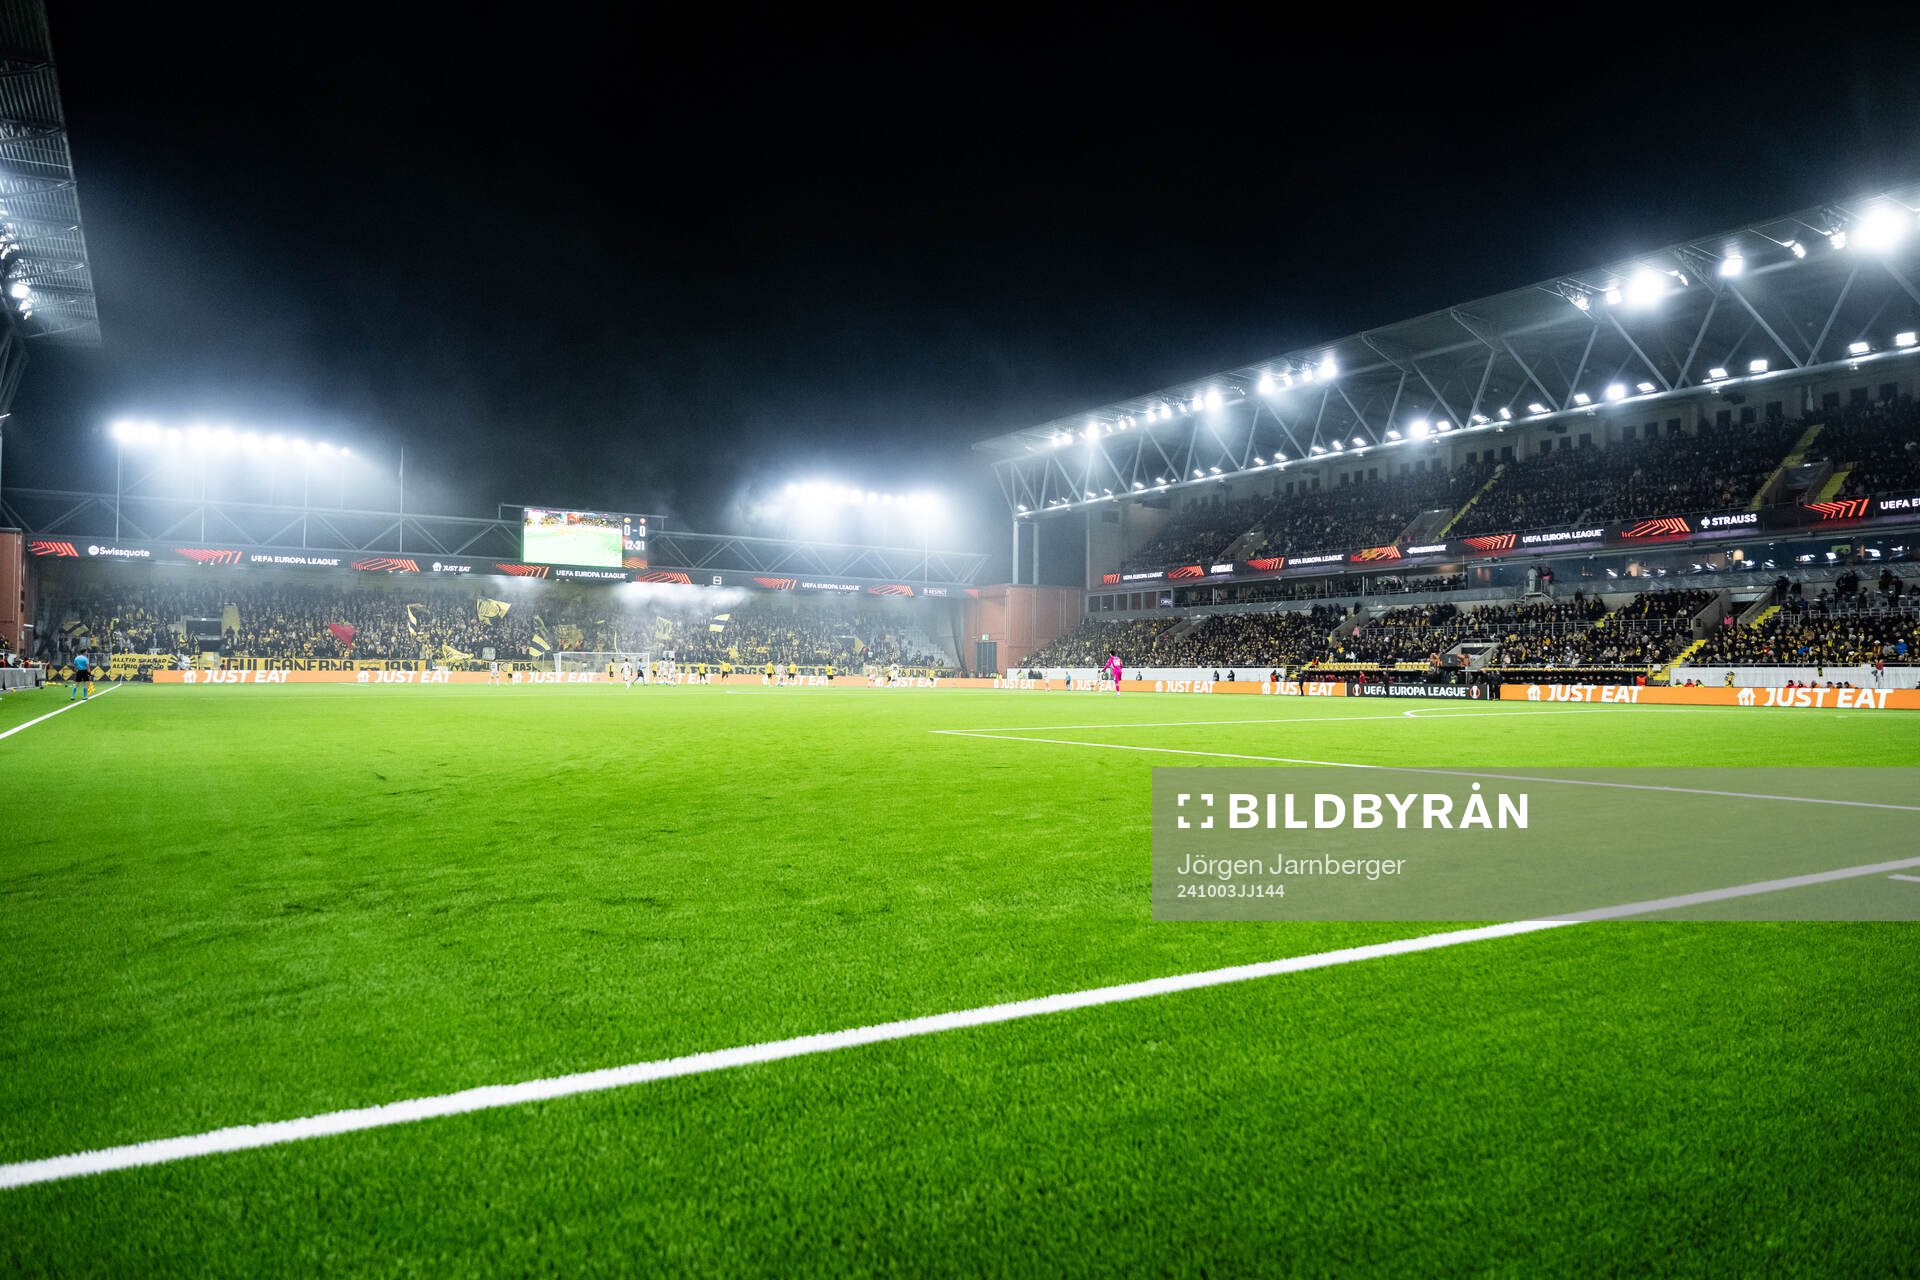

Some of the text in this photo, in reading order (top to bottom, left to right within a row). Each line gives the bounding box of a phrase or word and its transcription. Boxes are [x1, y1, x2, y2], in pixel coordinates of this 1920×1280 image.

[1880, 500, 1910, 510] UEFA
[1711, 513, 1757, 527] STRAUSS
[1522, 529, 1602, 544] UEFA EUROPA LEAGUE
[100, 547, 150, 558] Swissquote
[251, 555, 339, 566] UEFA EUROPA LEAGUE
[1288, 554, 1344, 566] UEFA EUROPA LEAGUE
[443, 565, 471, 573] JUST EAT
[555, 569, 626, 579] UEFA EUROPA LEAGUE
[817, 582, 838, 590] EUROPA
[839, 583, 860, 591] LEAGUE
[202, 669, 292, 683] JUST EAT
[373, 670, 453, 683] JUST EAT
[528, 671, 597, 683] JUST EAT
[1001, 678, 1035, 689] JUST EAT
[1166, 680, 1216, 693] JUST EAT
[1308, 682, 1336, 696] EAT
[1363, 685, 1467, 697] UEFA EUROPA LEAGUE
[1546, 684, 1644, 703] JUST EAT
[1763, 687, 1894, 709] JUST EAT
